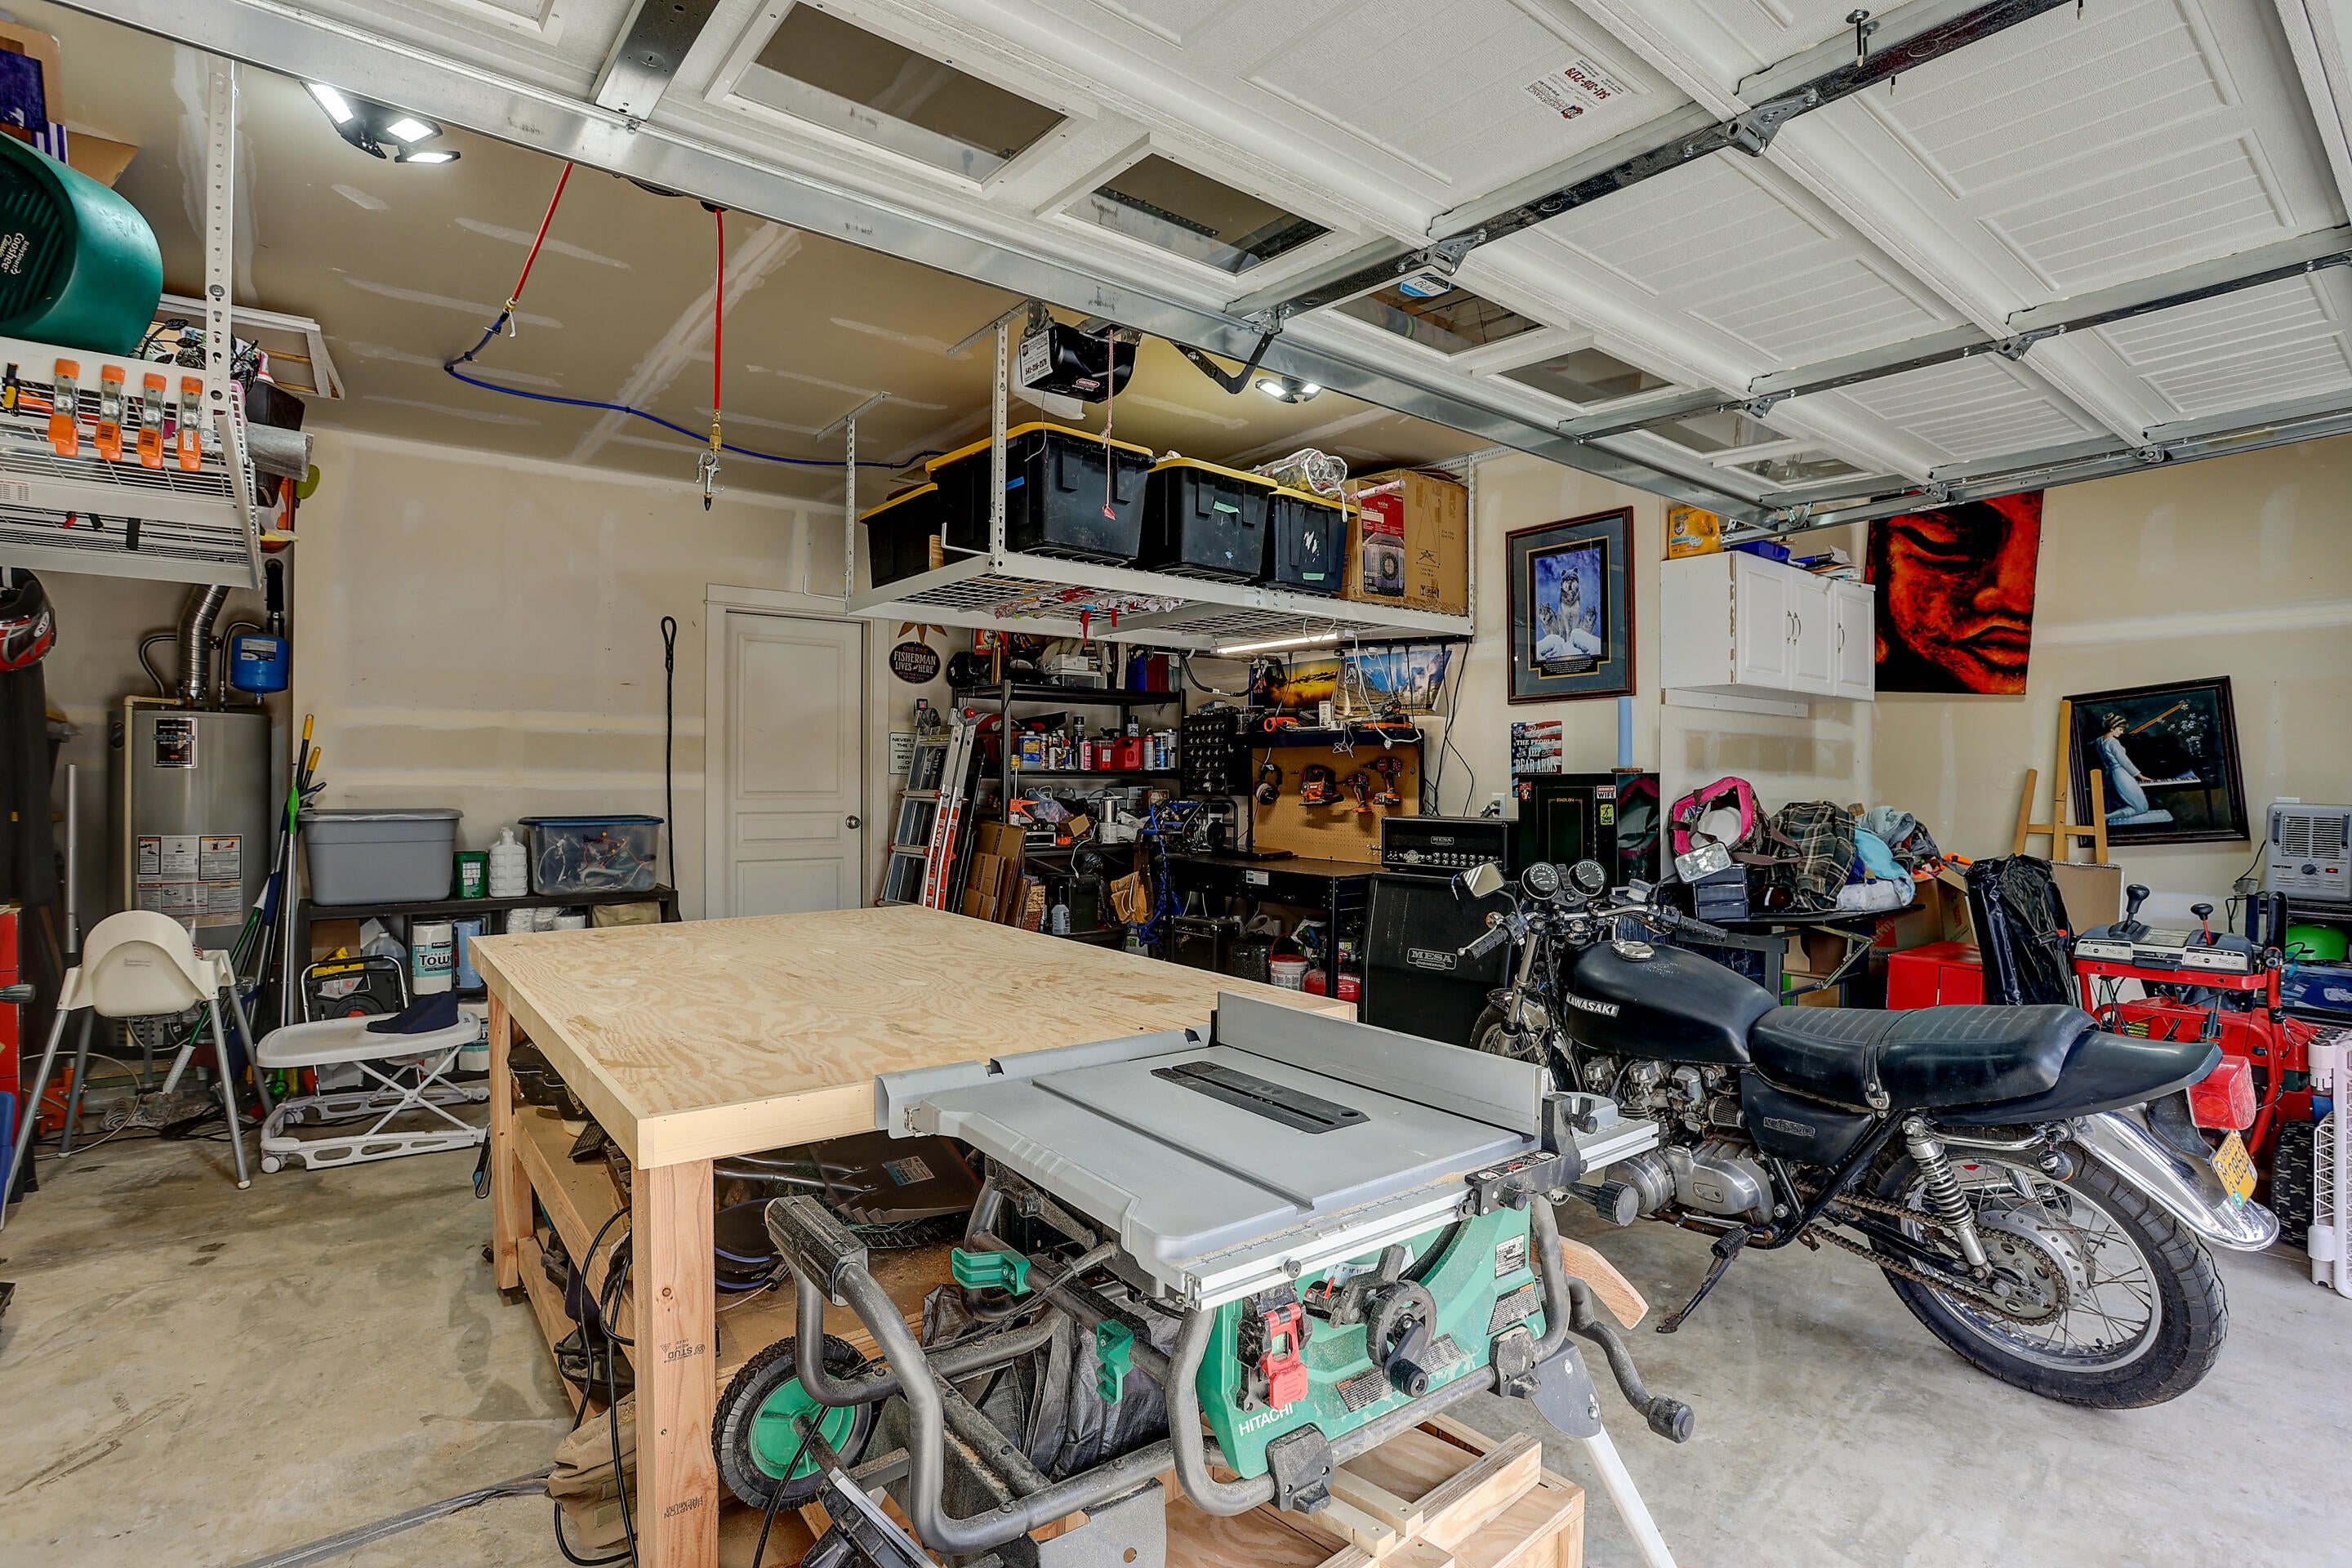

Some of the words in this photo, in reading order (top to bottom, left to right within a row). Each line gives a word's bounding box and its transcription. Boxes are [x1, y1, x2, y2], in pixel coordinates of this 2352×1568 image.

[1564, 67, 1611, 100] 541-316-2179
[1524, 86, 1563, 112] PERFORMANCE
[894, 650, 937, 666] FISHERMAN
[895, 661, 912, 671] LIVES
[917, 664, 934, 674] HERE
[1528, 747, 1541, 757] KEEP
[1516, 759, 1535, 773] BEAR
[1536, 758, 1557, 773] ARMS
[1410, 950, 1453, 963] MESA
[1566, 994, 1616, 1015] KAWASAKI
[668, 1347, 693, 1359] STUD
[1238, 1402, 1294, 1437] HITACHI
[664, 1499, 703, 1519] HAMPTON
[666, 1495, 703, 1511] PREMIUM
